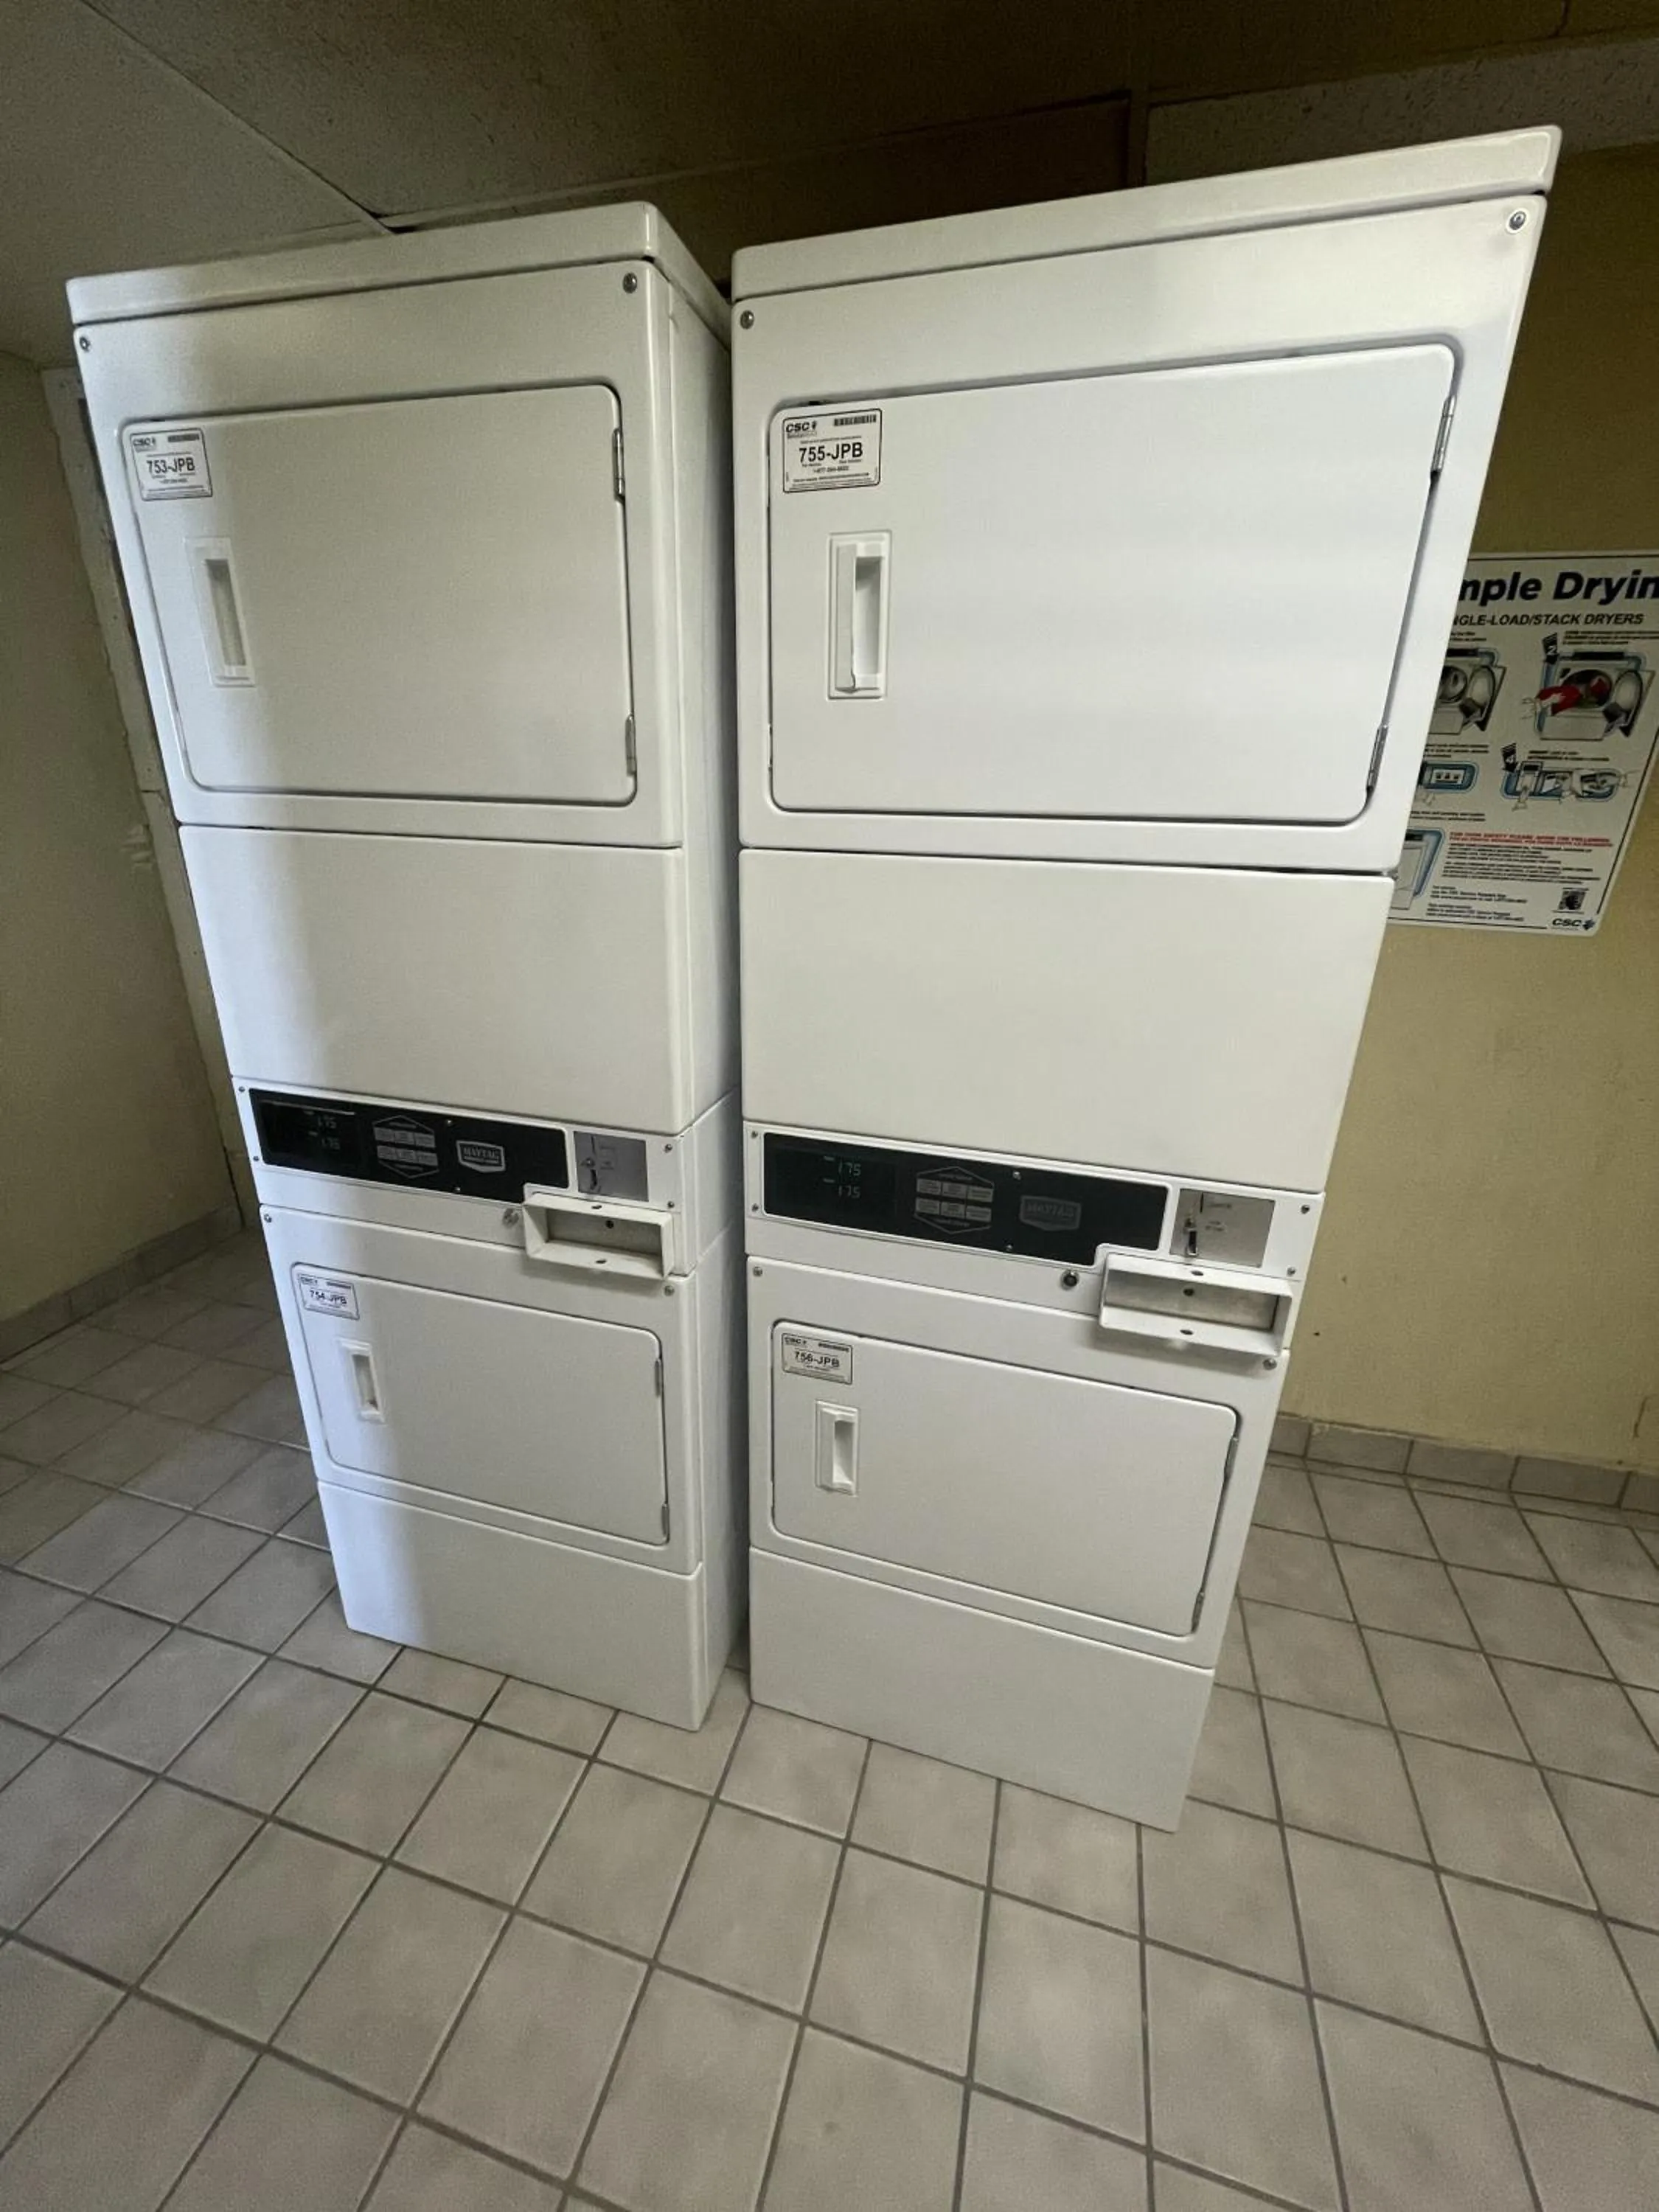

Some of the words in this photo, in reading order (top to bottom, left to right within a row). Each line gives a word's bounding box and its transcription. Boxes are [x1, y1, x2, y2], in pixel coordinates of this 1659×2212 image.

[786, 422, 810, 433] CSC
[799, 442, 863, 464] 755-JPB
[146, 457, 195, 473] 753-JPB
[1585, 613, 1644, 625] DRYERS
[1548, 645, 1557, 655] 2
[1552, 918, 1582, 927] CSC
